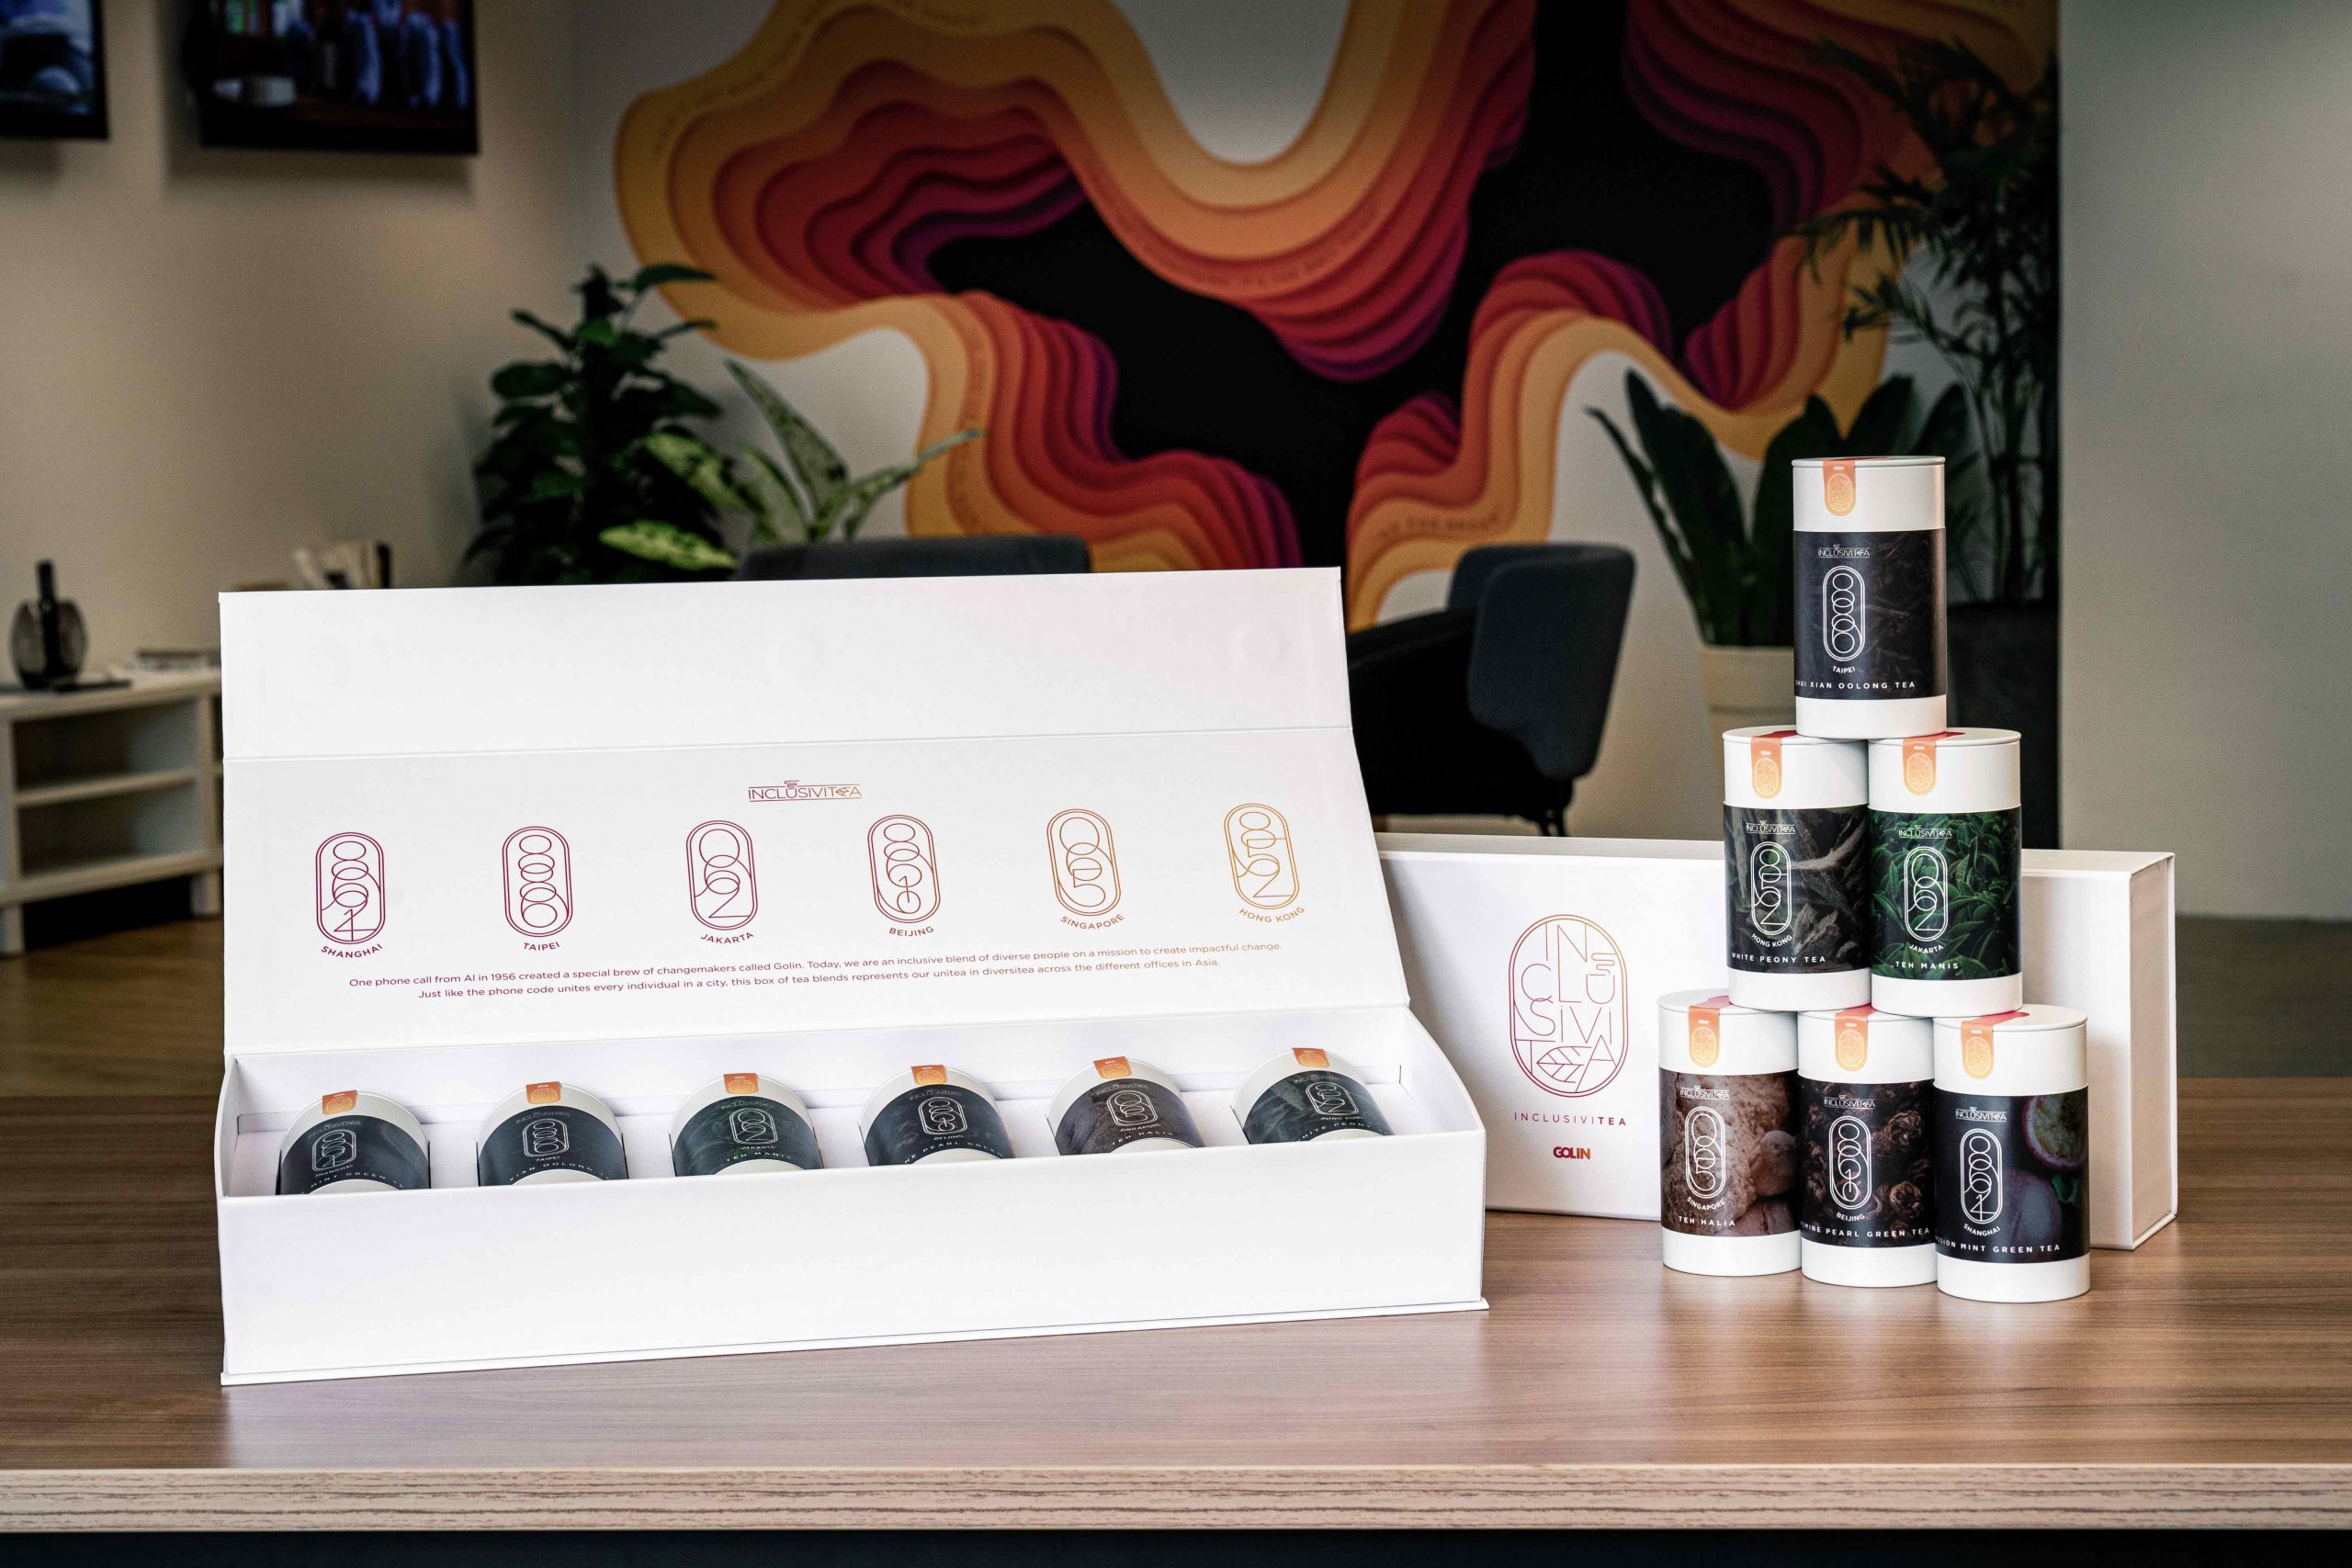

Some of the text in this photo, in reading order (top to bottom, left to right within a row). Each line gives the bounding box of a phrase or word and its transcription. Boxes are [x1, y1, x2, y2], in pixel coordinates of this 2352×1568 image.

[1239, 906, 1305, 922] HONG KONG
[1060, 913, 1125, 931] SINGAPORE
[700, 931, 754, 944] JAKARTA
[888, 926, 934, 937] BEIJING
[1752, 933, 1792, 947] HONG KONG
[321, 943, 383, 958] SHANGHAI
[524, 942, 560, 952] TAIPEI
[1909, 944, 1944, 954] JAKARTA
[1732, 953, 1754, 962] WHITE
[349, 978, 372, 987] One
[375, 977, 411, 987] phone
[413, 976, 432, 985] call
[435, 976, 461, 984] from
[478, 974, 489, 982] in
[491, 973, 516, 981] 1956
[518, 971, 560, 980] created
[572, 968, 610, 979] special
[613, 968, 640, 976] brew
[643, 966, 654, 976] of
[656, 964, 737, 976] changemakers
[739, 963, 771, 972] called
[773, 962, 805, 970] Golin.
[807, 960, 842, 969] Today,
[945, 954, 976, 964] blend
[978, 953, 989, 962] of
[991, 953, 1031, 962] diverse
[1033, 951, 1070, 961] people
[1189, 943, 1238, 953] impactful
[1895, 961, 1914, 969] TEH
[418, 989, 442, 998] Just
[445, 989, 464, 998] like
[467, 988, 485, 997] the
[488, 987, 524, 997] phone
[526, 986, 554, 994] code
[557, 985, 591, 993] unites
[594, 984, 624, 992] every
[627, 980, 680, 990] individual
[684, 980, 694, 988] in
[706, 979, 729, 988] city,
[731, 977, 752, 986] this
[777, 976, 789, 984] of
[792, 976, 809, 984] tea
[812, 974, 849, 983] blends
[852, 972, 909, 982] represents
[933, 969, 967, 977] unitea
[982, 966, 1035, 976] diversitea
[1095, 962, 1141, 971] different
[1195, 958, 1220, 966] Asia.
[1514, 1111, 1626, 1126] INCLUSIVITEA
[1553, 1146, 1591, 1159] GOLIN
[1687, 1196, 1726, 1211] SINGAPORE
[1679, 1215, 1695, 1224] TEH
[1836, 1212, 1865, 1222] BEIJING
[1826, 1228, 1860, 1237] PEARL
[1963, 1224, 2001, 1236] SHANGHAI
[1961, 1243, 1985, 1252] MINT
[2040, 1244, 2060, 1252] TEA
